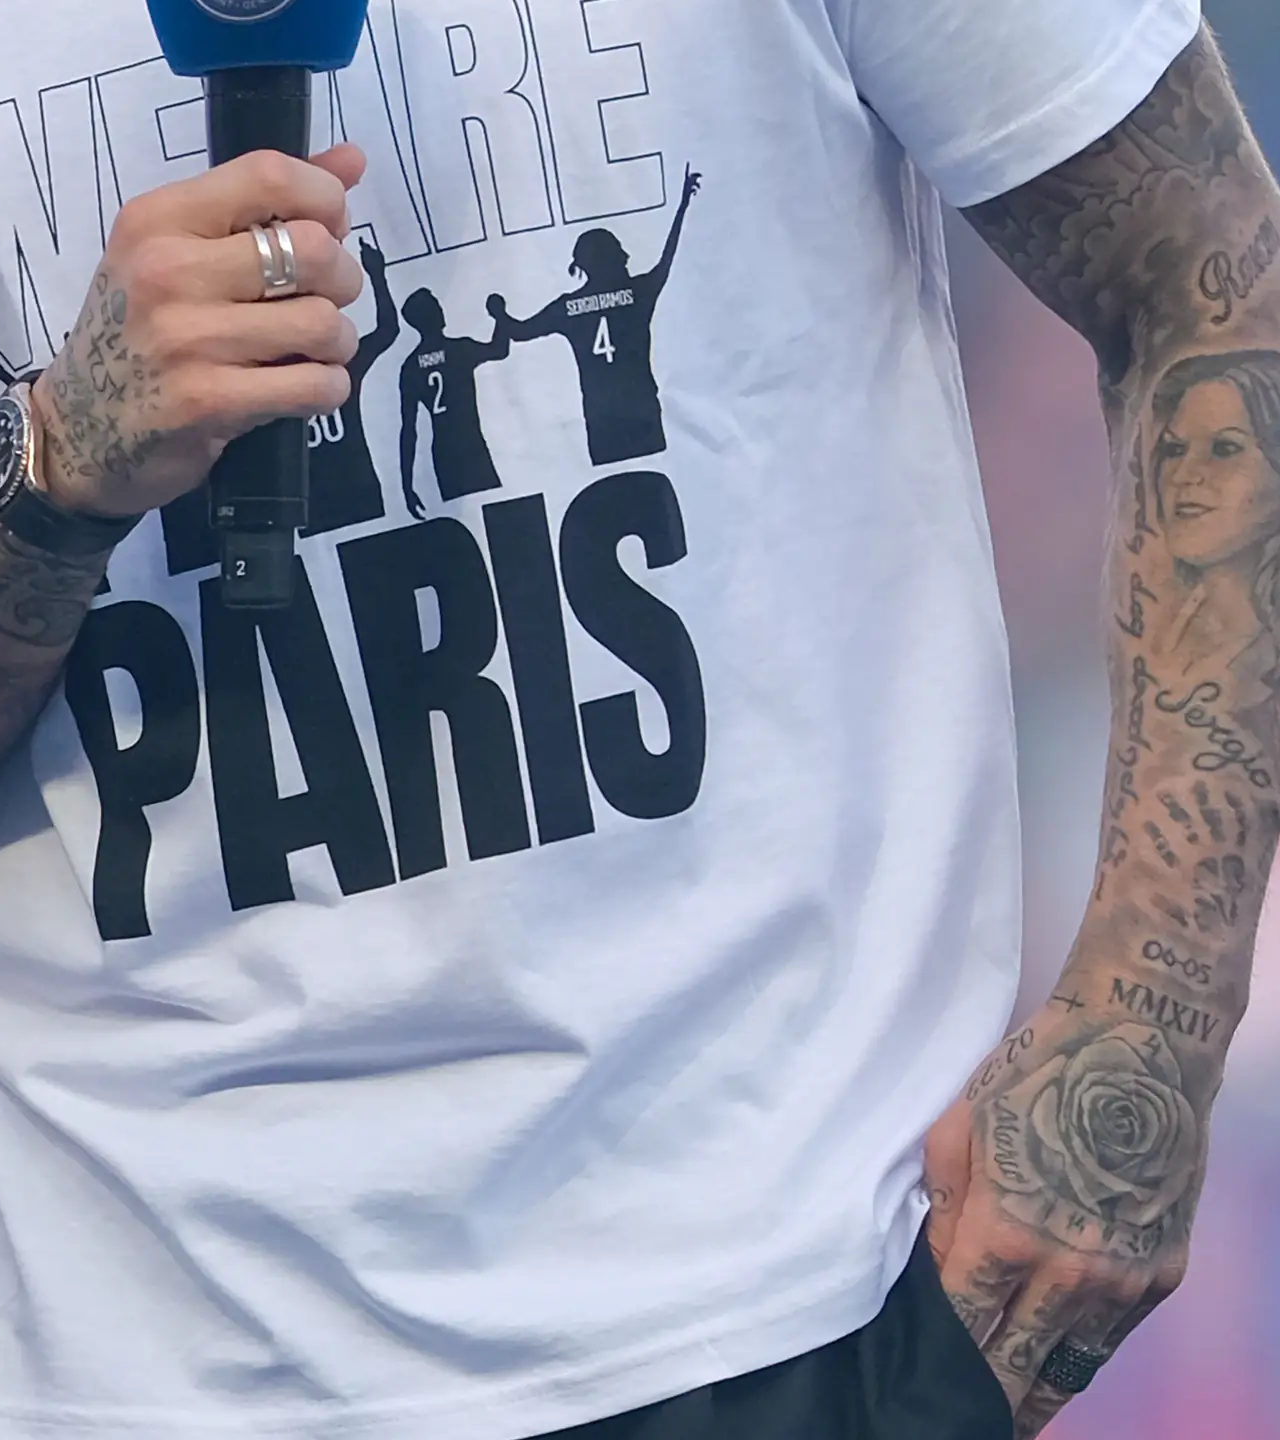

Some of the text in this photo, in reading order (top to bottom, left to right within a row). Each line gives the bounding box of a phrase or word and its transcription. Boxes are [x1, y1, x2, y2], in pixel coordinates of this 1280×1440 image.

[565, 288, 634, 317] SERGIO RAMOS
[592, 315, 617, 364] 4
[427, 370, 448, 415] 2
[235, 560, 247, 576] 2
[64, 470, 707, 941] PARIS
[1154, 681, 1272, 790] Sergio
[1107, 977, 1220, 1043] MMXIV
